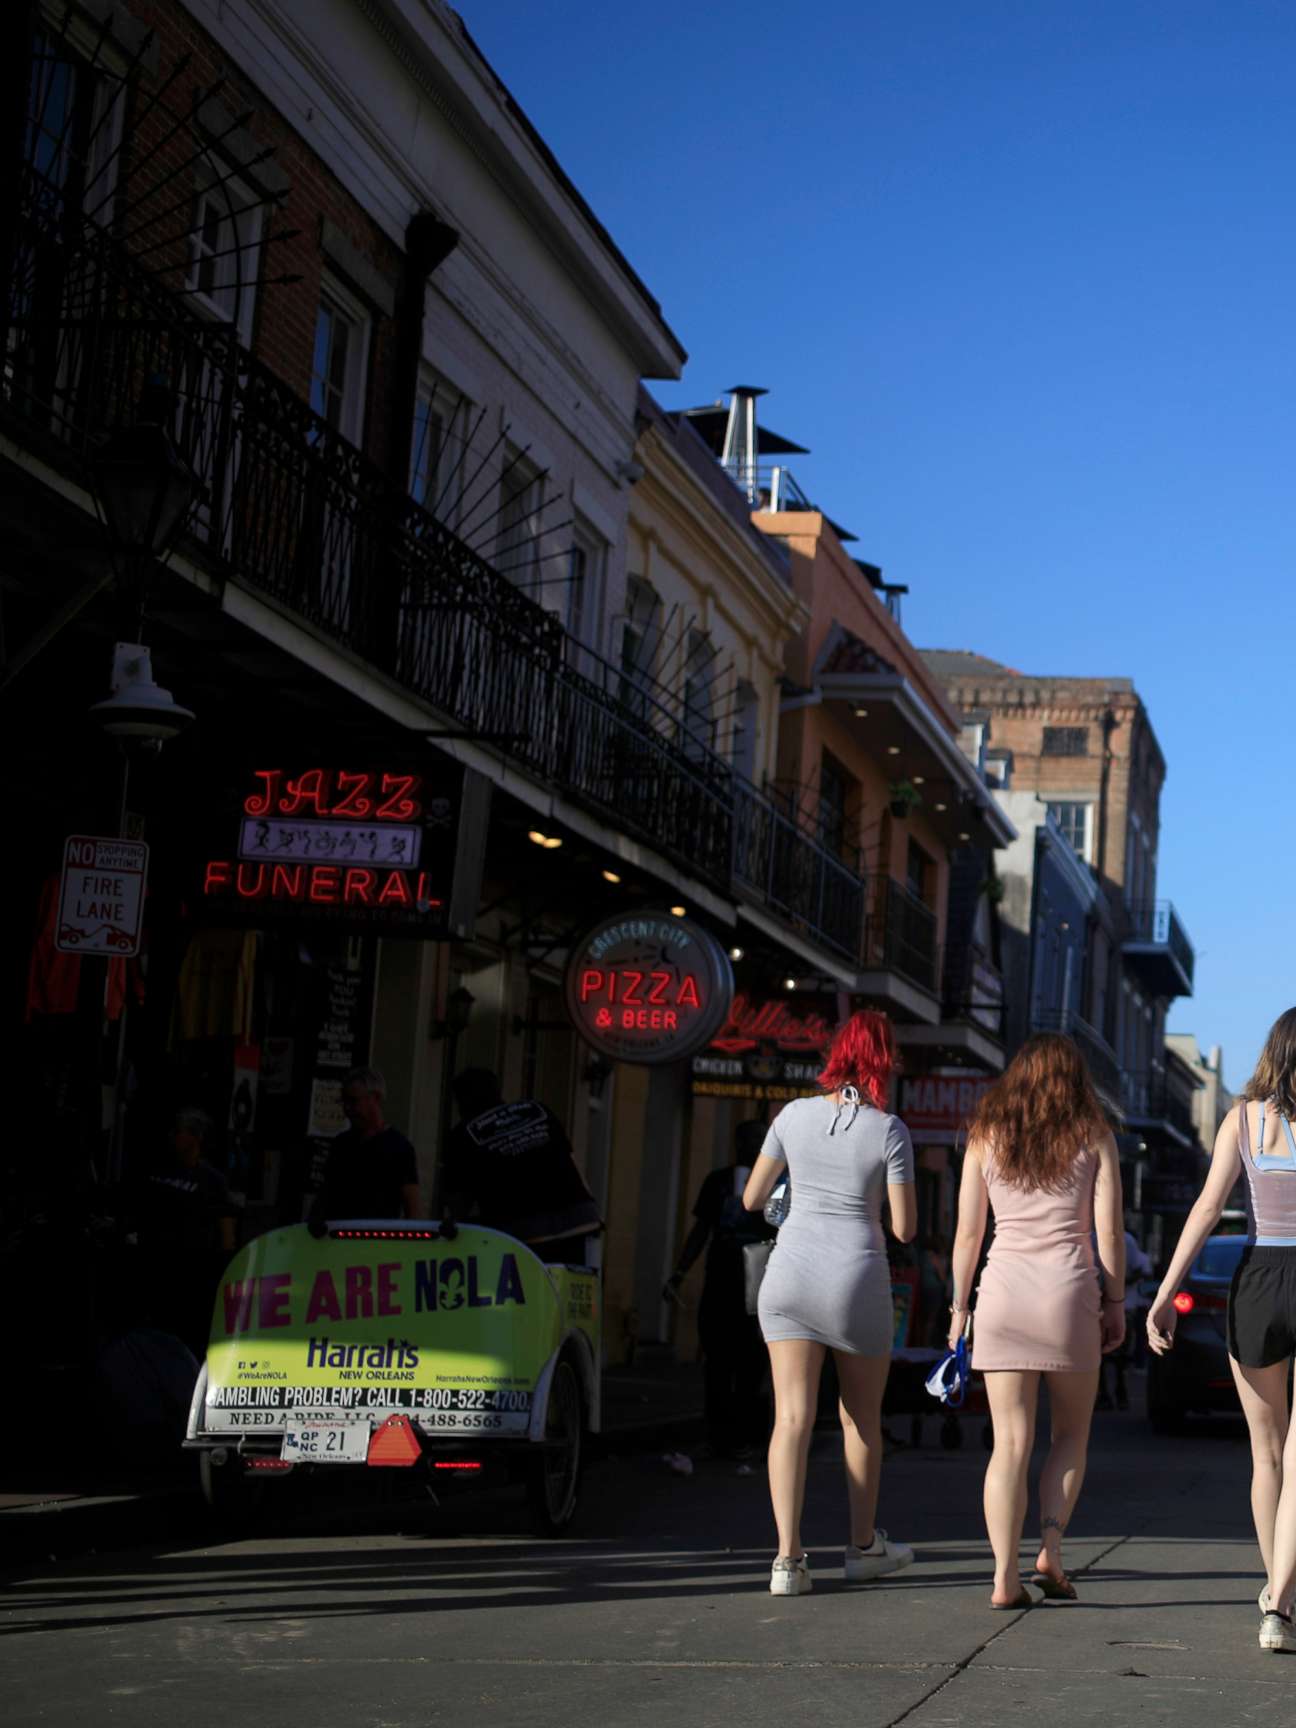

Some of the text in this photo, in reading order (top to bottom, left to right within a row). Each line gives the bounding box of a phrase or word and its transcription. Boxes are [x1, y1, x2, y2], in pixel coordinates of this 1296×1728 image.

[243, 767, 419, 820] JAZZ
[69, 841, 96, 865] NO
[83, 876, 124, 897] FIRE
[203, 861, 444, 909] FUNERAL
[76, 900, 124, 921] LANE
[588, 920, 691, 960] CRESCENT CITY
[581, 968, 701, 1009] PIZZA
[595, 1007, 678, 1031] & BEER
[784, 1062, 821, 1080] SHAC
[223, 1253, 526, 1335] WE ARE NOLA
[237, 1371, 288, 1381] #WeAreNOLA
[339, 1369, 416, 1382] NEW ORLEANS
[284, 1386, 364, 1408] PROBLEM?
[366, 1387, 405, 1408] CALL
[230, 1412, 275, 1425] NEED
[393, 1412, 502, 1428] 4-488-6565
[300, 1431, 319, 1441] QP
[326, 1431, 345, 1451] 21
[300, 1443, 318, 1452] NC
